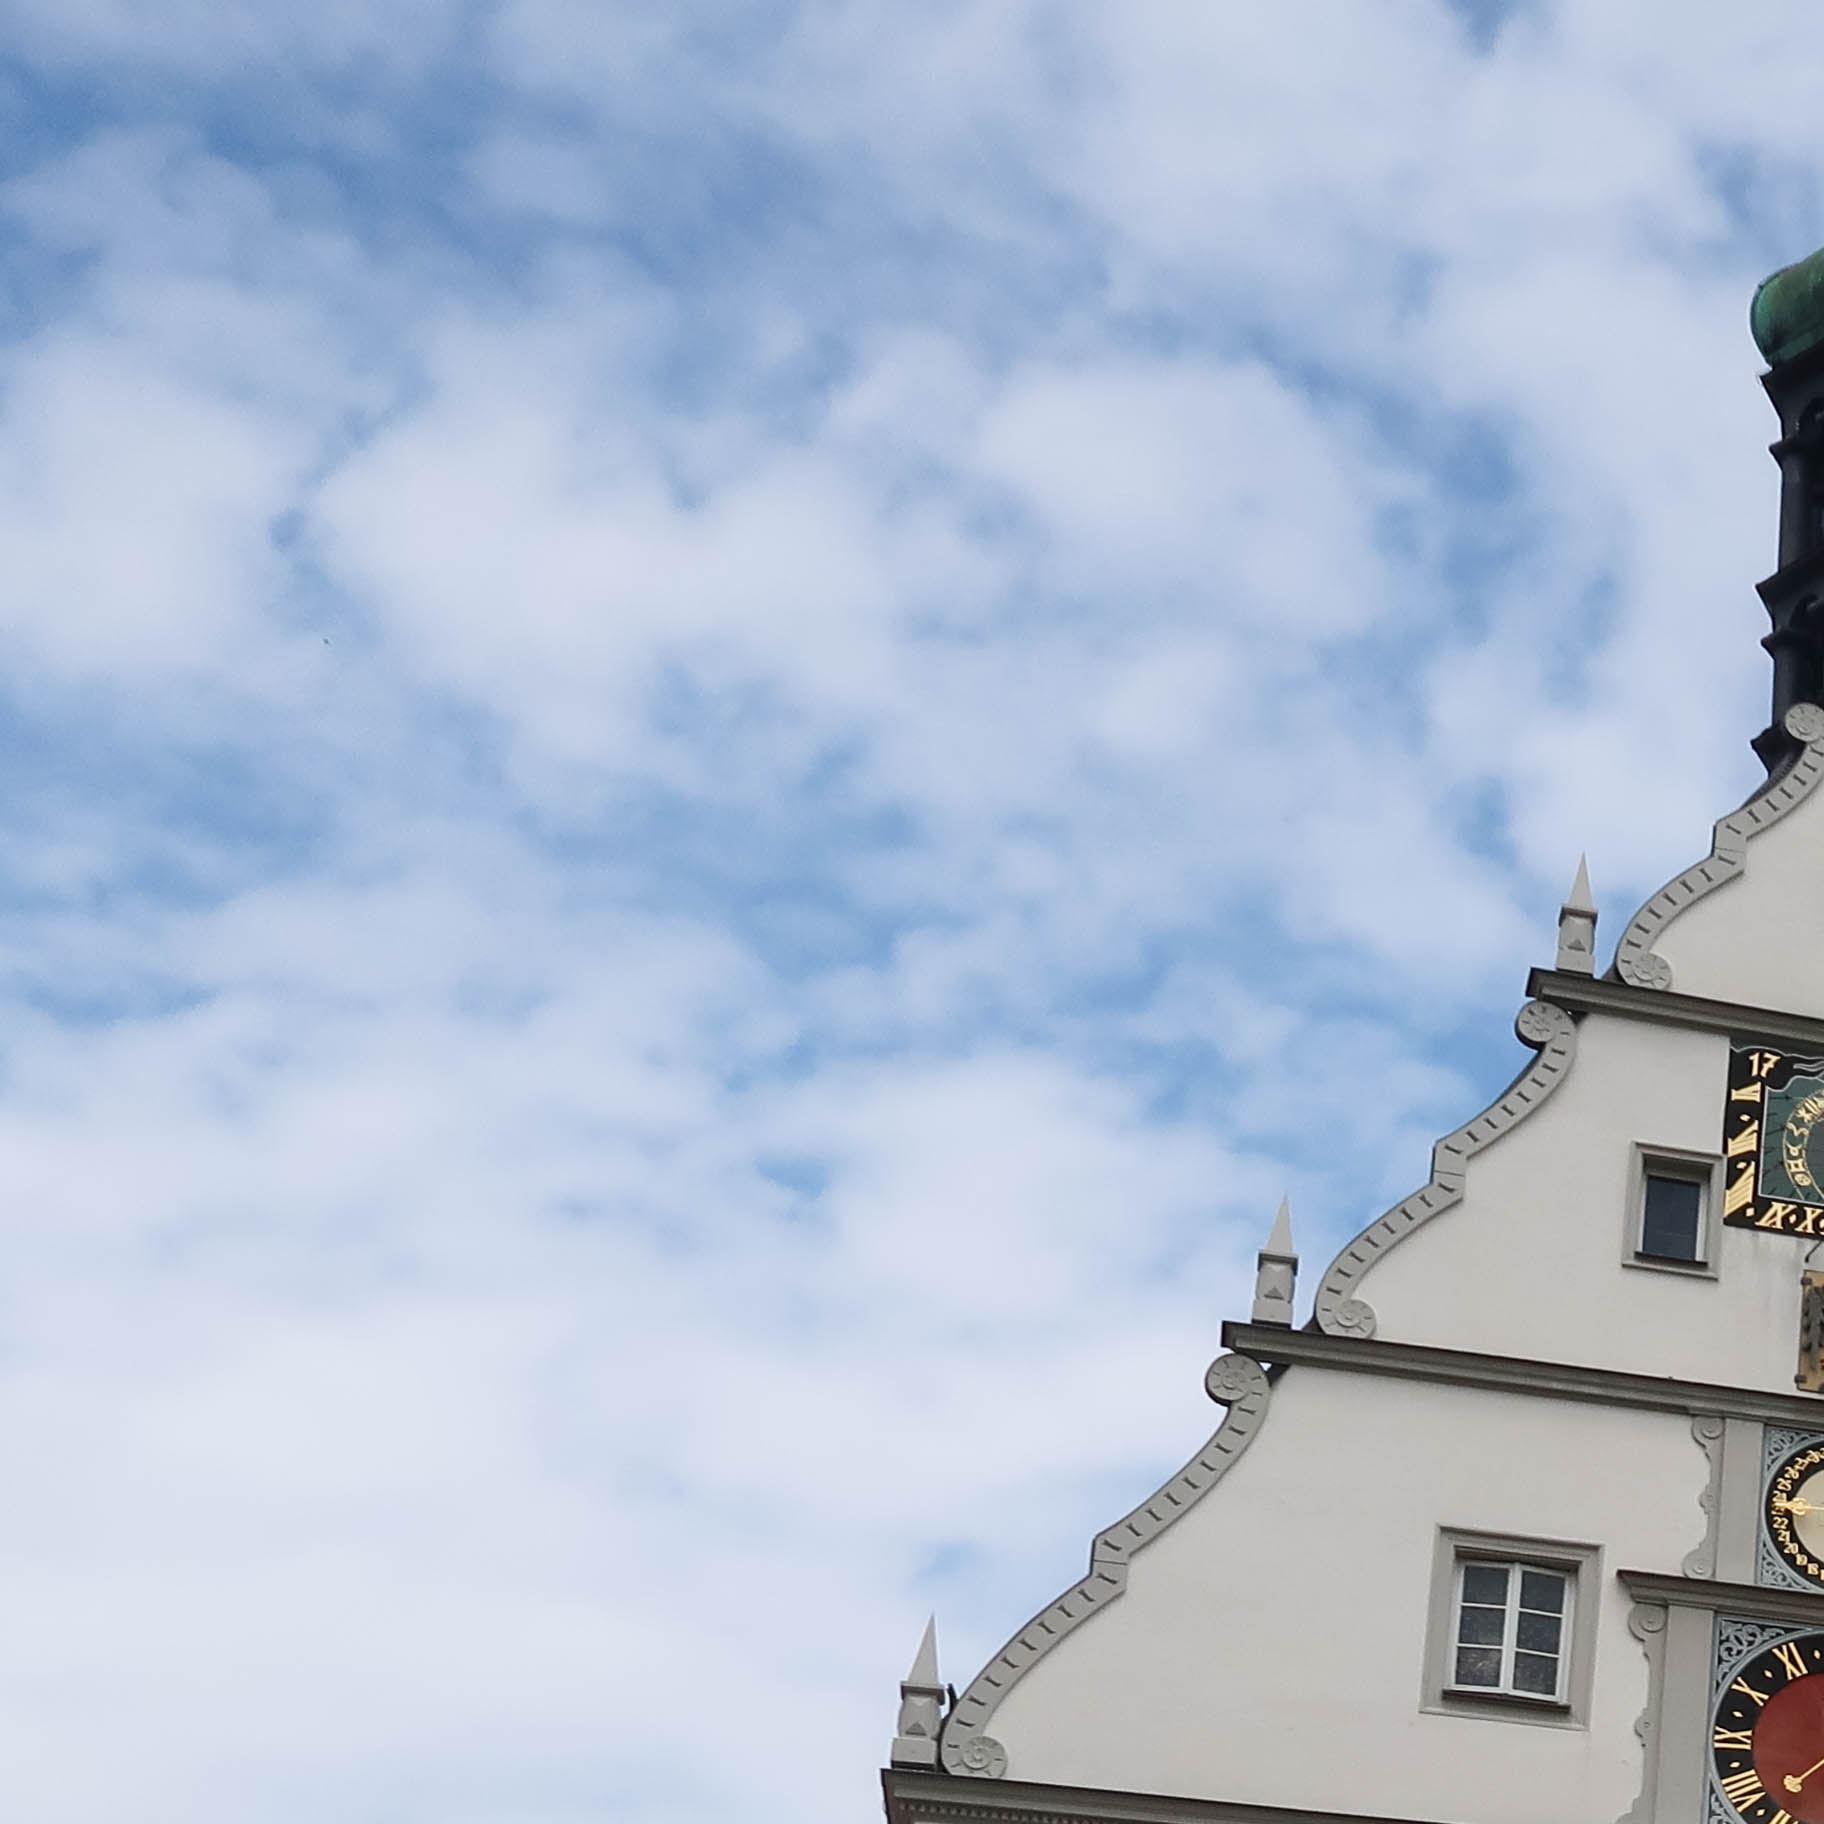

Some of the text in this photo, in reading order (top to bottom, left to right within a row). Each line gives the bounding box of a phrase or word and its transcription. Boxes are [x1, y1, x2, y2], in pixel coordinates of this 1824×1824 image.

[1749, 1052, 1781, 1078] 17
[1772, 1516, 1789, 1529] 22
[1777, 1530, 1791, 1543] 21
[1783, 1542, 1799, 1554] 20
[1772, 1641, 1808, 1680] XI
[1731, 1676, 1769, 1706] X
[1713, 1726, 1752, 1750] IX
[1721, 1769, 1767, 1812] VIII
